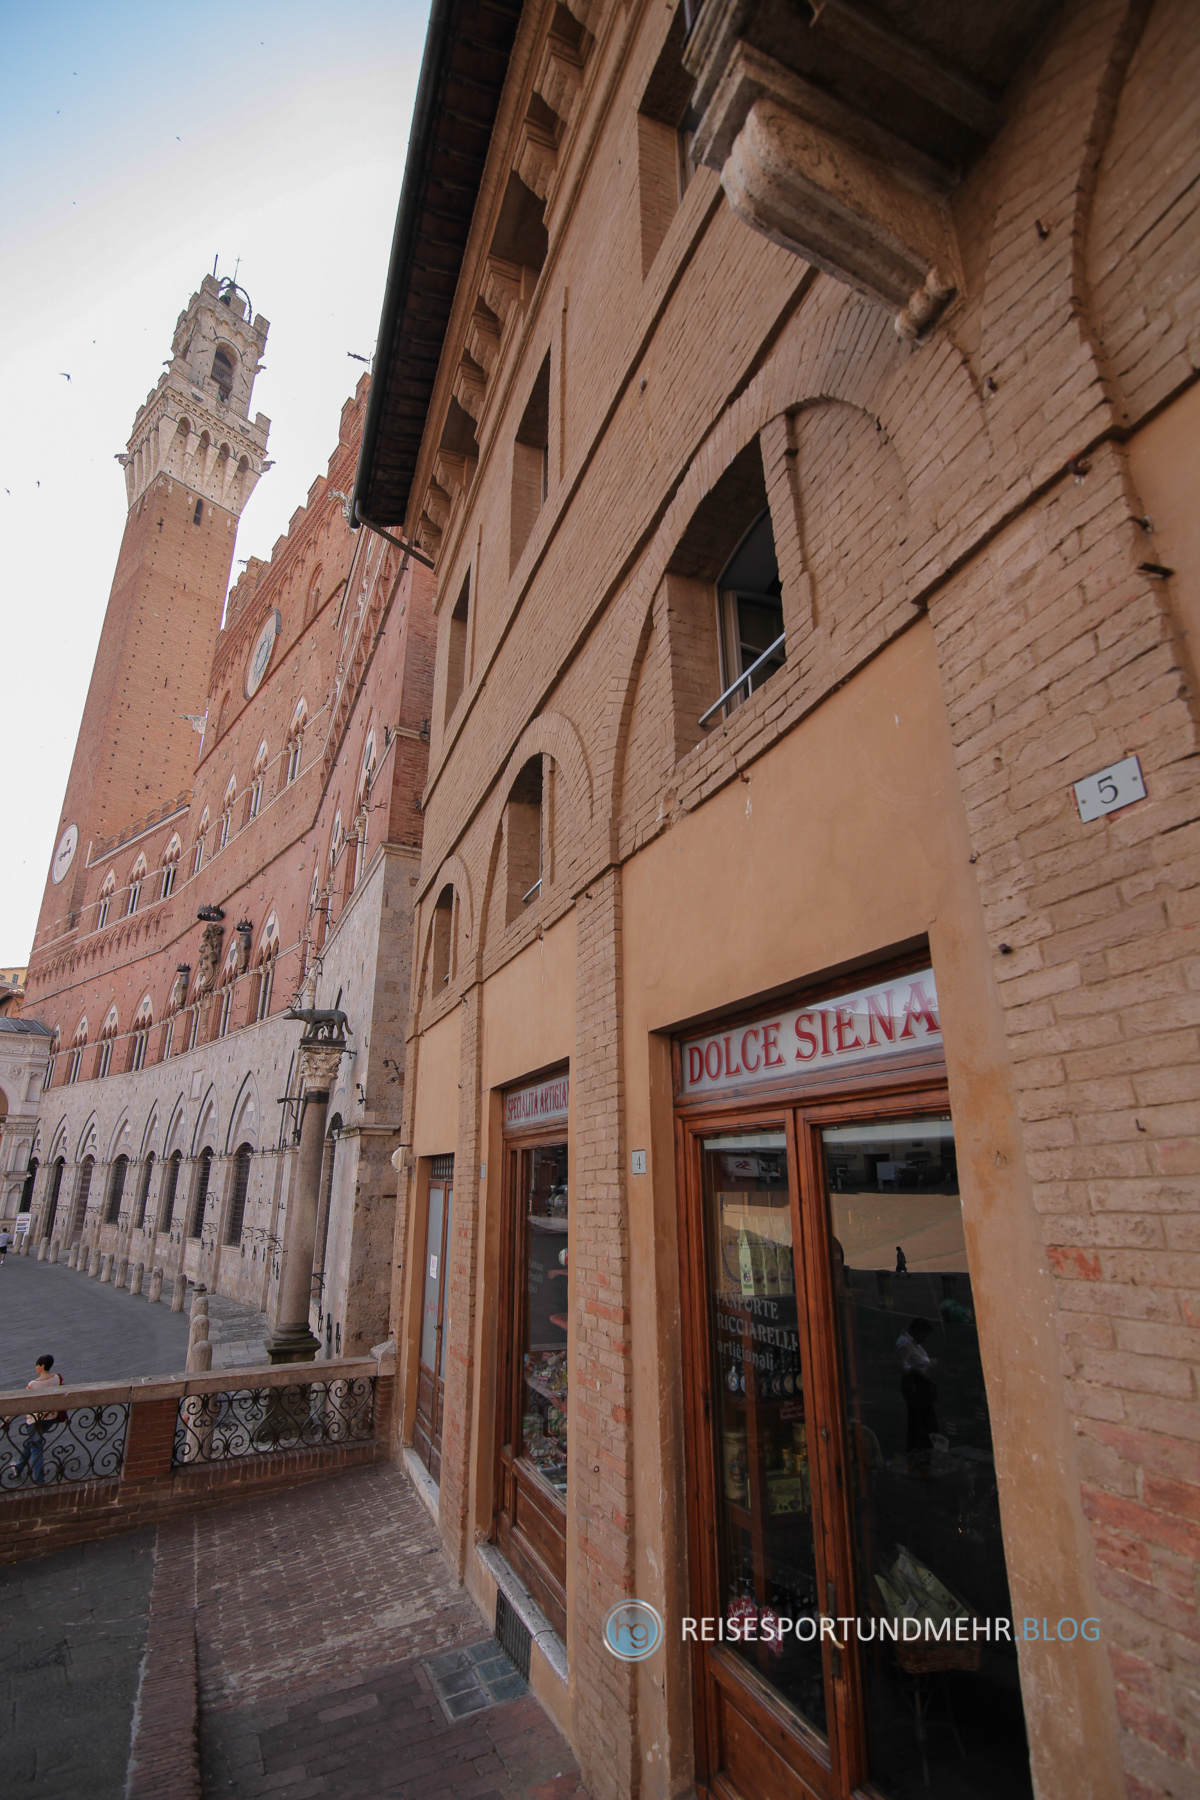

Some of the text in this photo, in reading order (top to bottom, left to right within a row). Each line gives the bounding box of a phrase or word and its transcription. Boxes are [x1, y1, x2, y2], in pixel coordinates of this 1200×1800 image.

[1097, 775, 1119, 804] 5
[688, 980, 942, 1086] DOLCE SIENA
[716, 1290, 779, 1320] PANFORTE
[716, 1313, 798, 1352] RICCIARELLI
